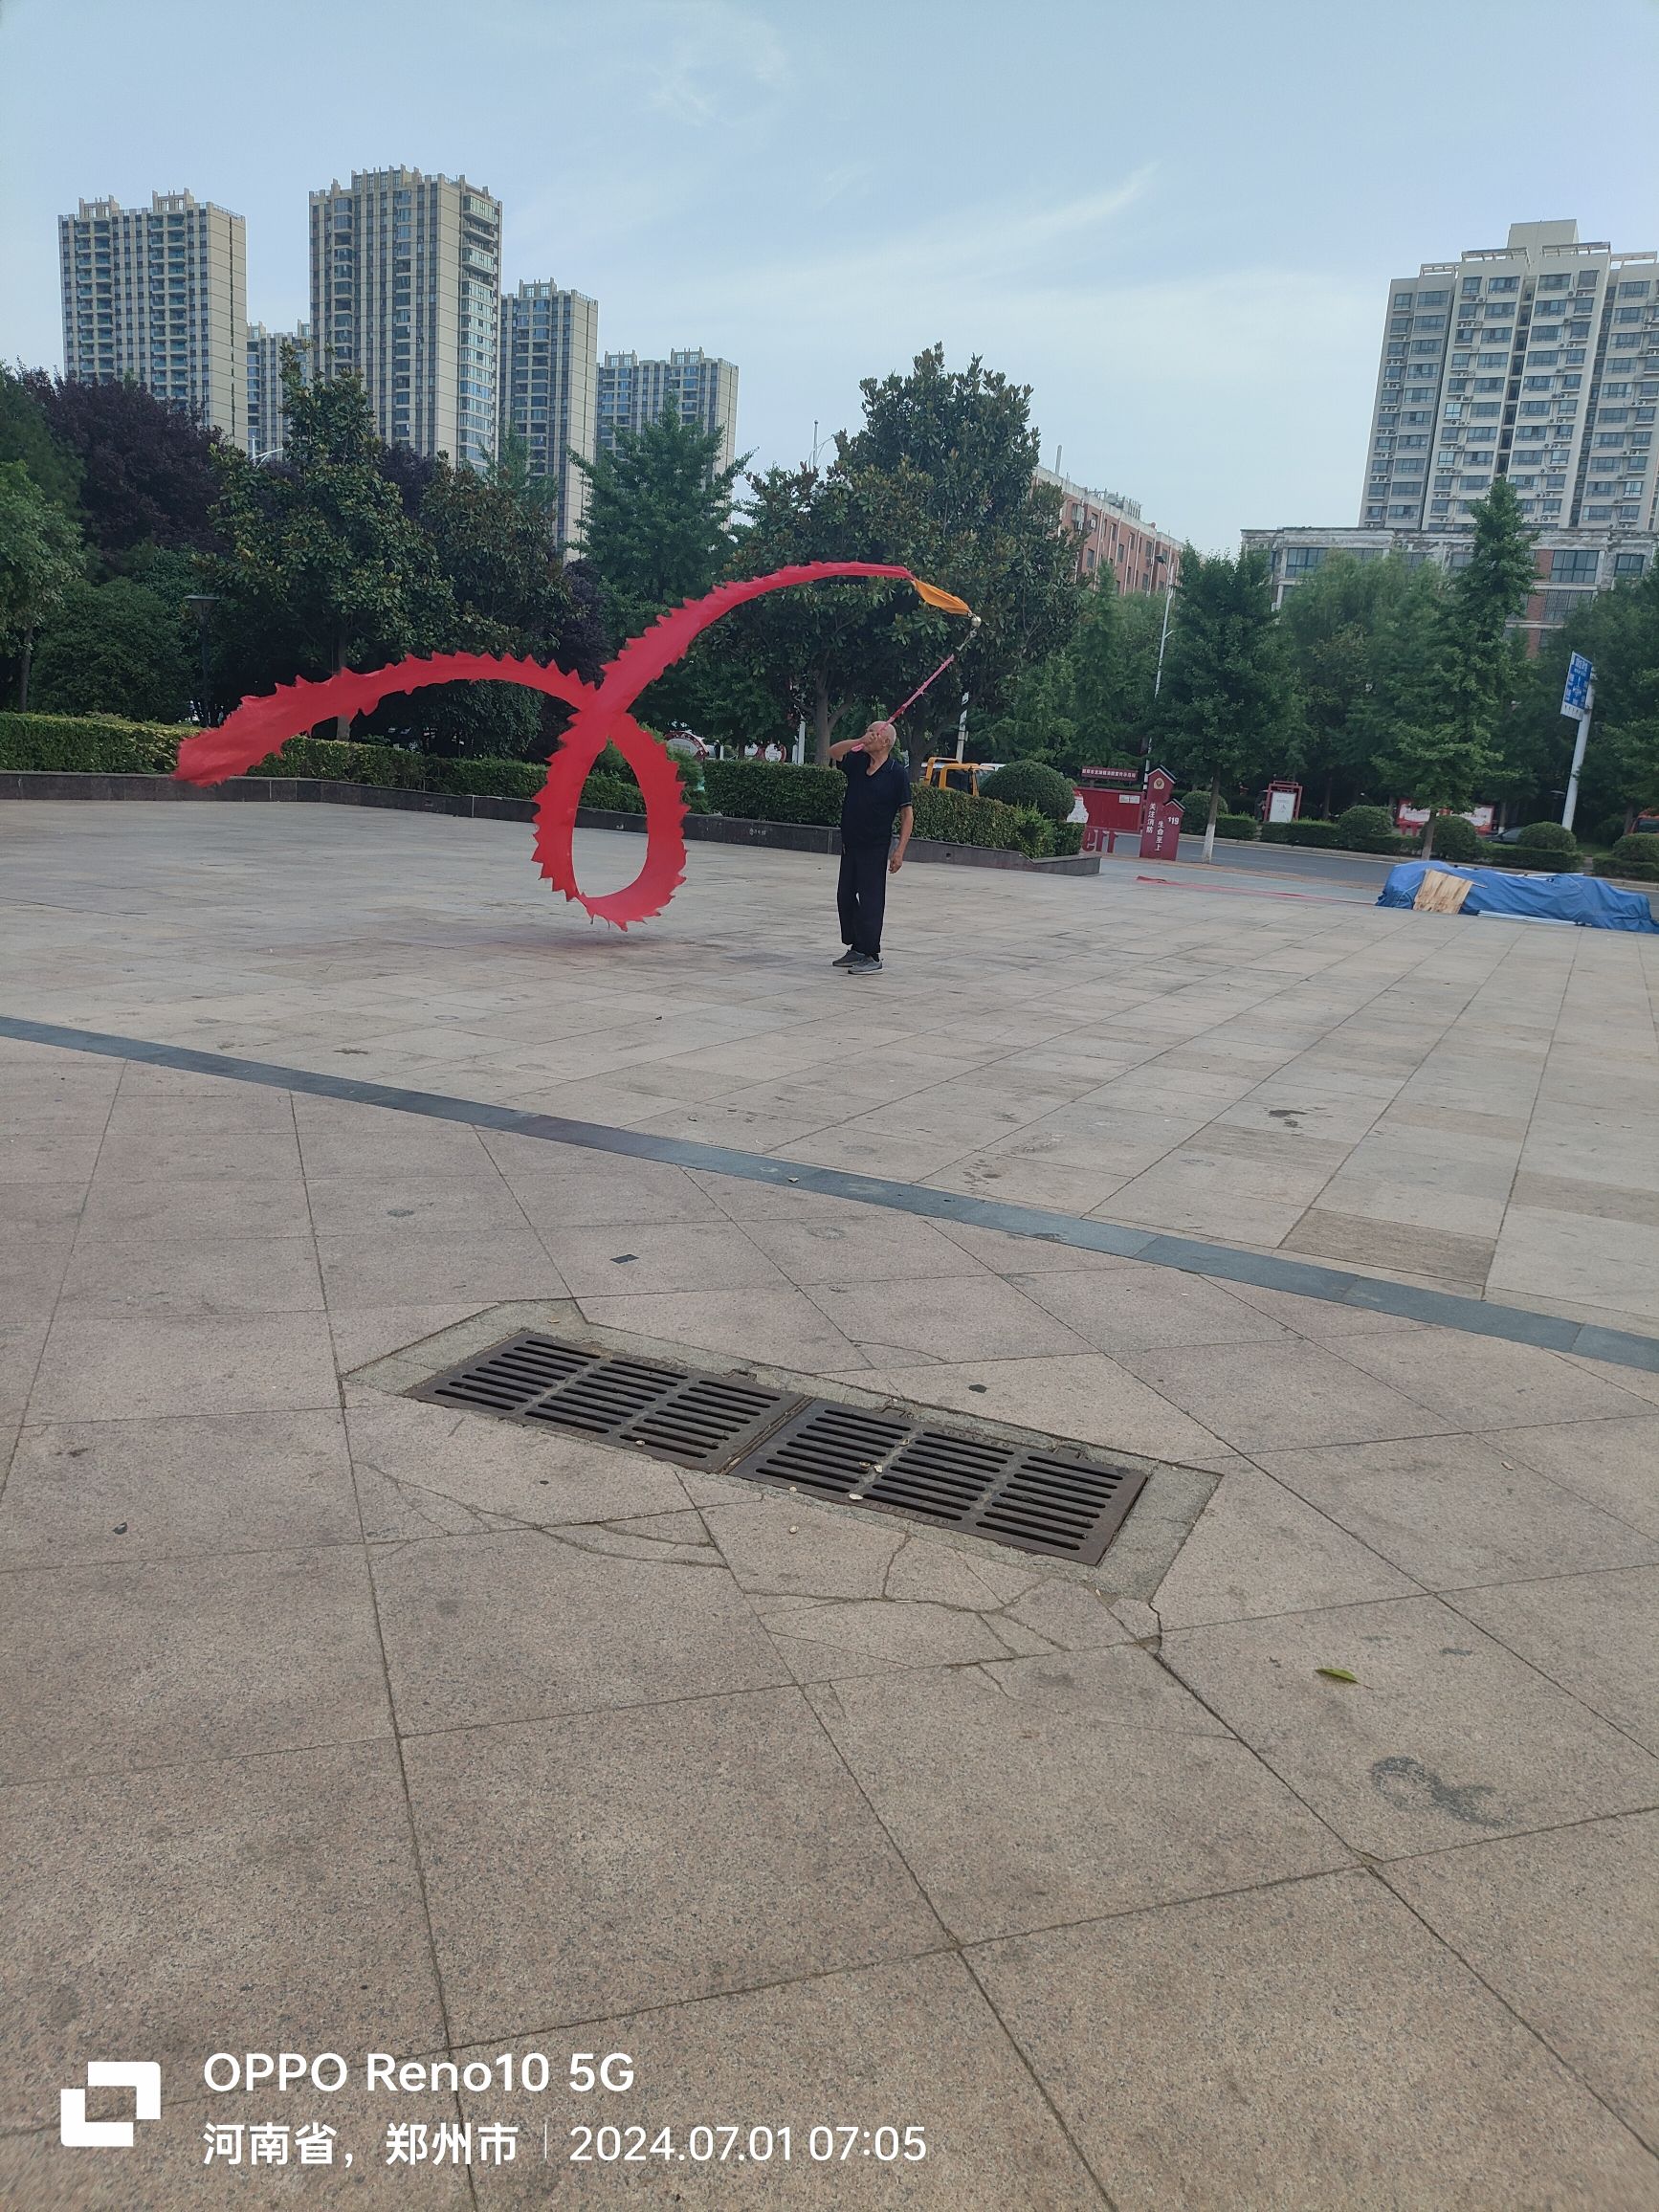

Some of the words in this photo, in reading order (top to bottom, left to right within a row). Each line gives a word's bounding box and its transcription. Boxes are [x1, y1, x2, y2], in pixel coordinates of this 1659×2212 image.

[1146, 803, 1157, 834] 关注消防
[1167, 816, 1180, 826] 119
[1154, 820, 1165, 852] 生命至上
